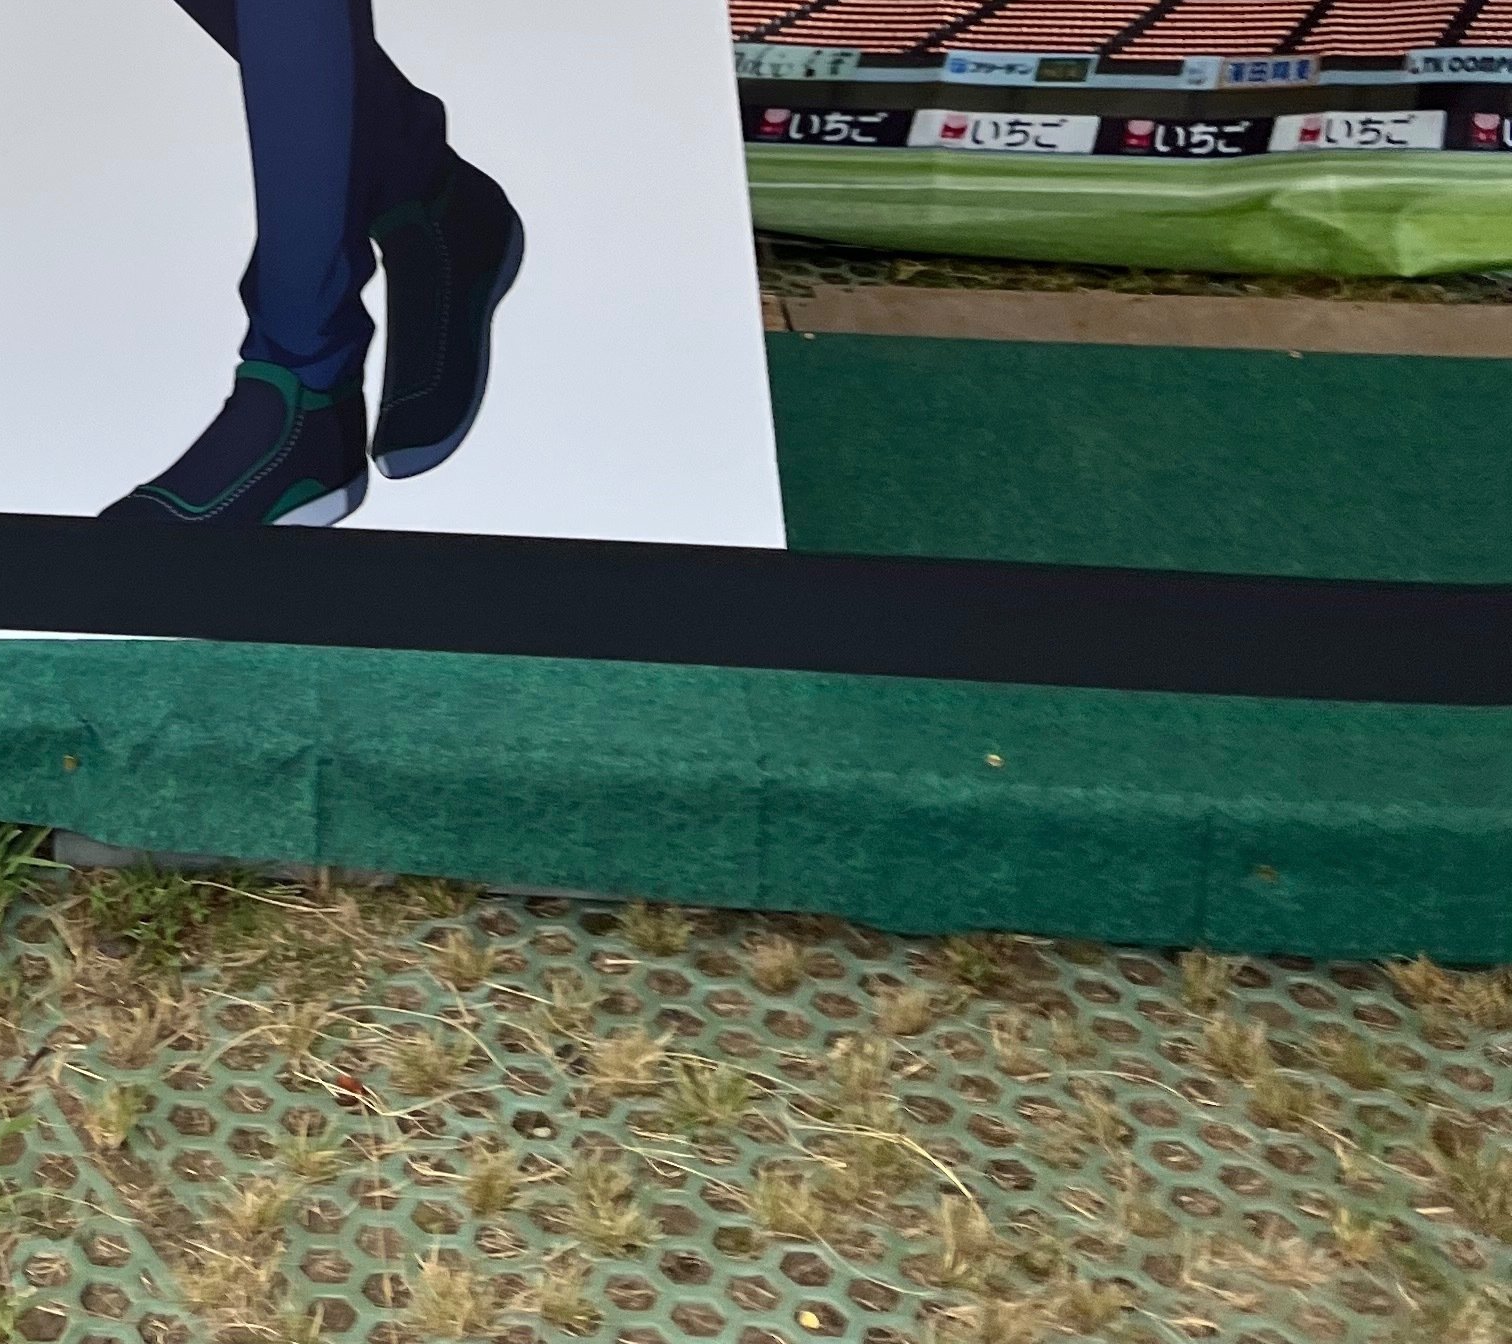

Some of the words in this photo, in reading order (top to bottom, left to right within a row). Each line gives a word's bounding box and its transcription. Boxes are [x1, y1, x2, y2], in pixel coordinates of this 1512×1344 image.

[788, 111, 888, 143] いちご
[971, 117, 1068, 149] いちご
[1154, 120, 1252, 154] いちご
[1324, 113, 1416, 145] いちご
